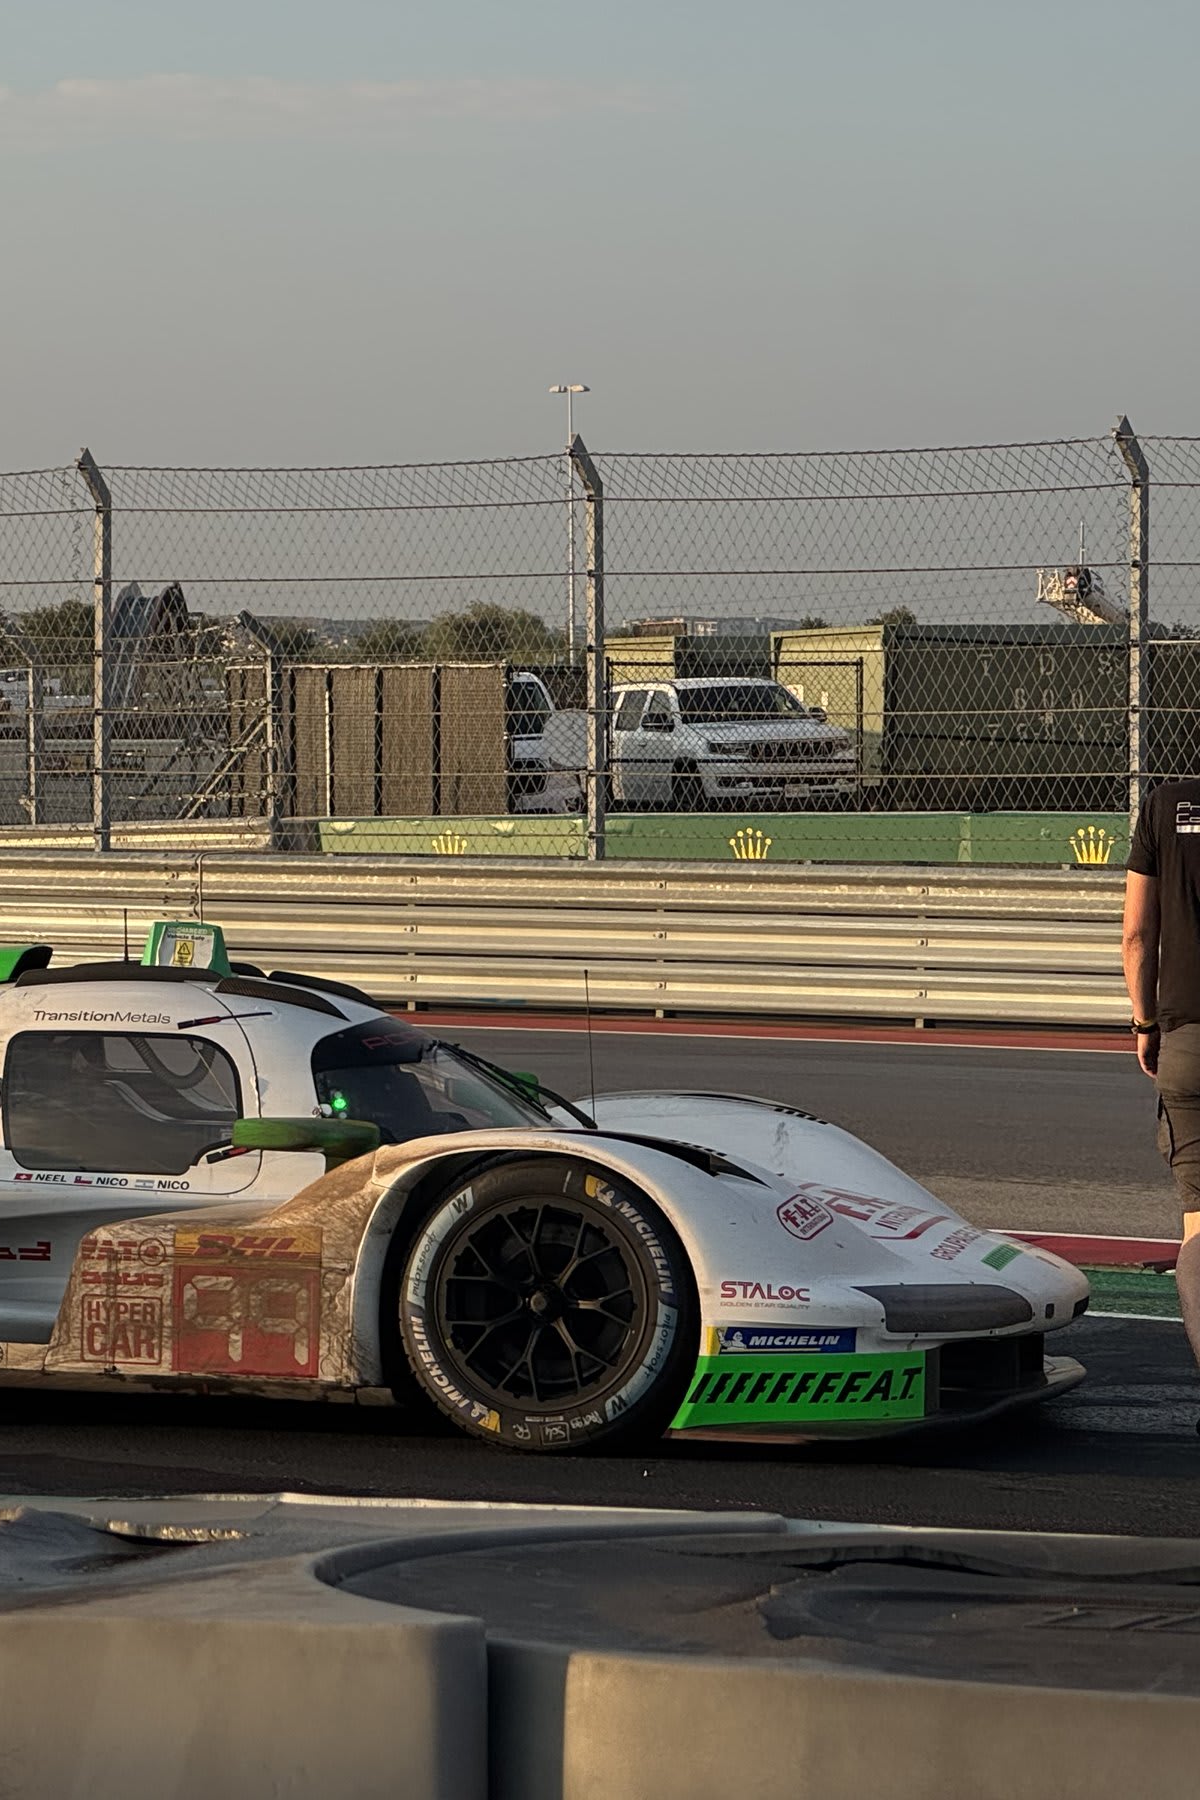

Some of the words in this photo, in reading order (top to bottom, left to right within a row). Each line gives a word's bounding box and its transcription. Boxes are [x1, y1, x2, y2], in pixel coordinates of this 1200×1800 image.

[33, 1010, 171, 1025] TransitionMetals
[35, 1173, 67, 1184] NEEL
[95, 1177, 129, 1188] NICO
[157, 1180, 190, 1192] NICO
[614, 1200, 674, 1295] MICHELIN
[720, 1280, 811, 1302] STALOC
[87, 1301, 156, 1323] HYPER
[86, 1321, 156, 1359] CAR
[749, 1335, 840, 1347] MICHELIN
[410, 1315, 470, 1410] MICHELIN
